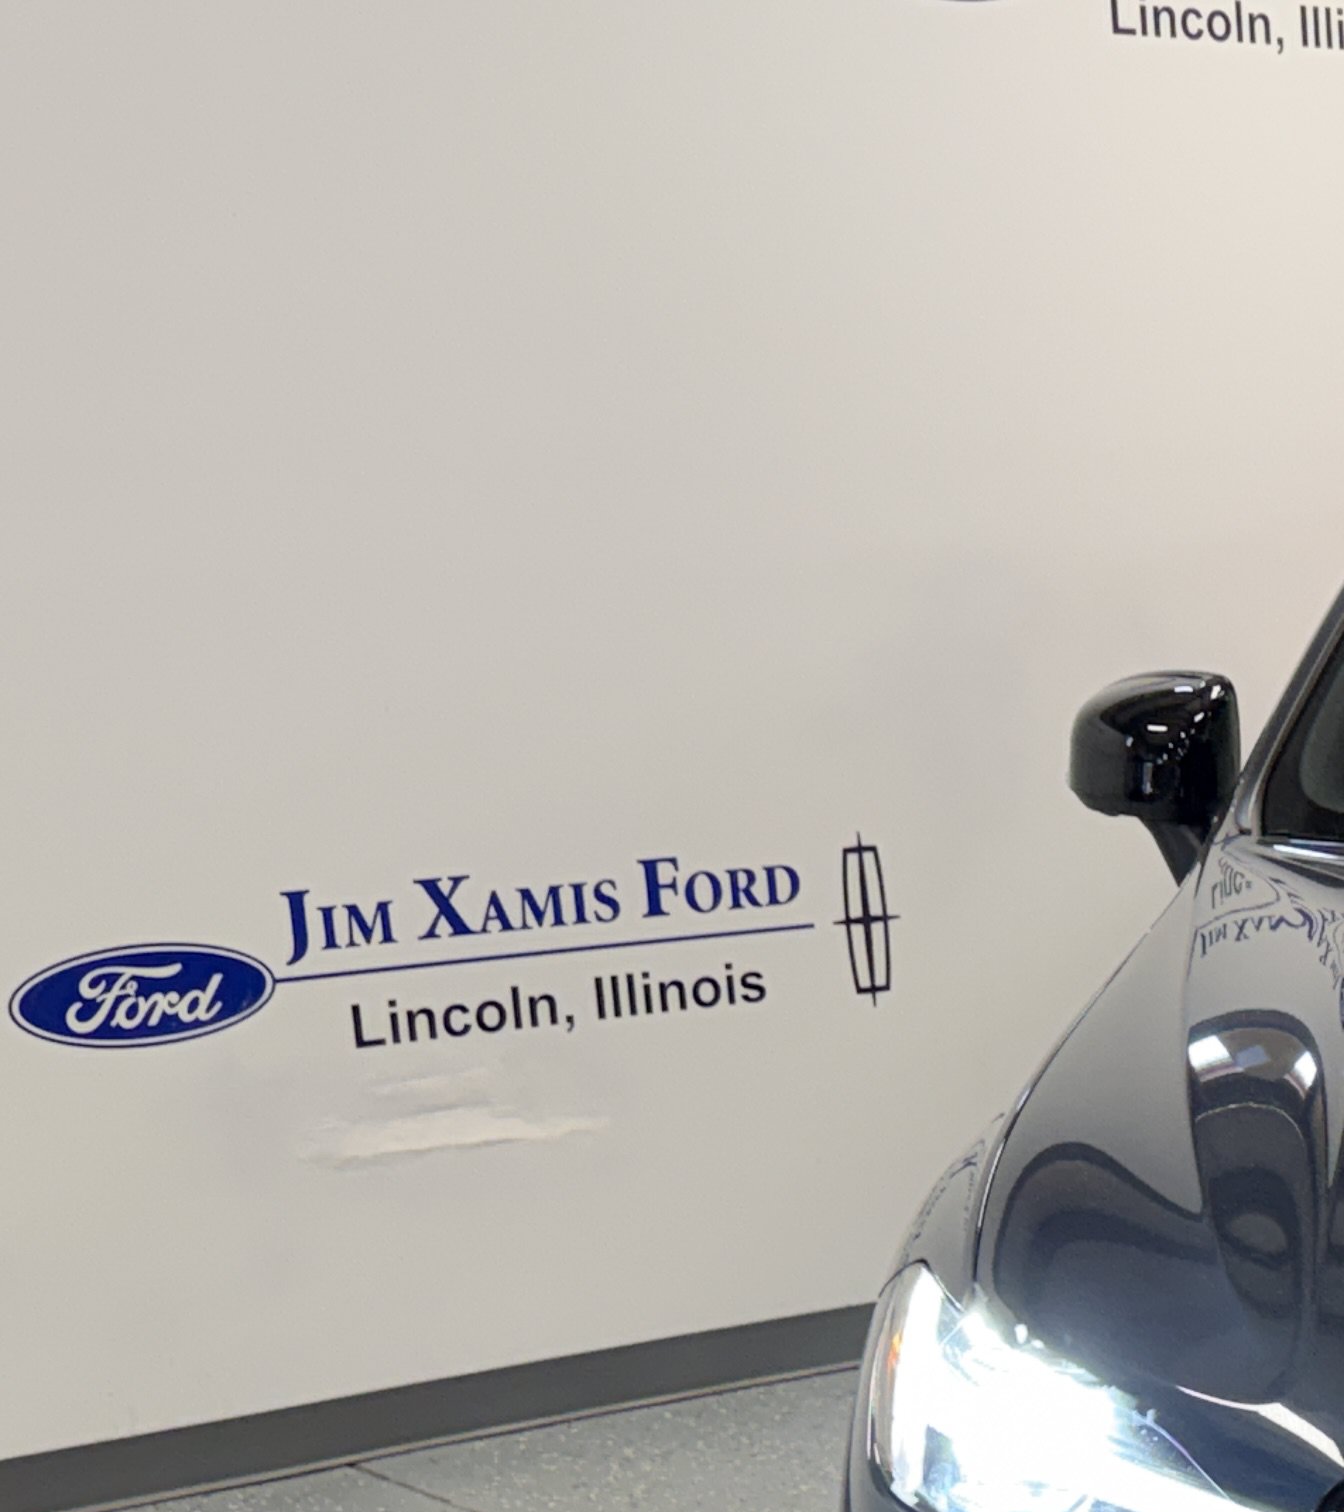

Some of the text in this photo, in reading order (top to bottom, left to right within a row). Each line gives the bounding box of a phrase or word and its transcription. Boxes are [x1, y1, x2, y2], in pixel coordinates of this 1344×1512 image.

[1110, 0, 1284, 53] Lincoln,
[281, 857, 801, 966] JIM XAMIS FORD
[65, 962, 224, 1034] Ford
[351, 963, 767, 1049] Lincoln, Illinois
